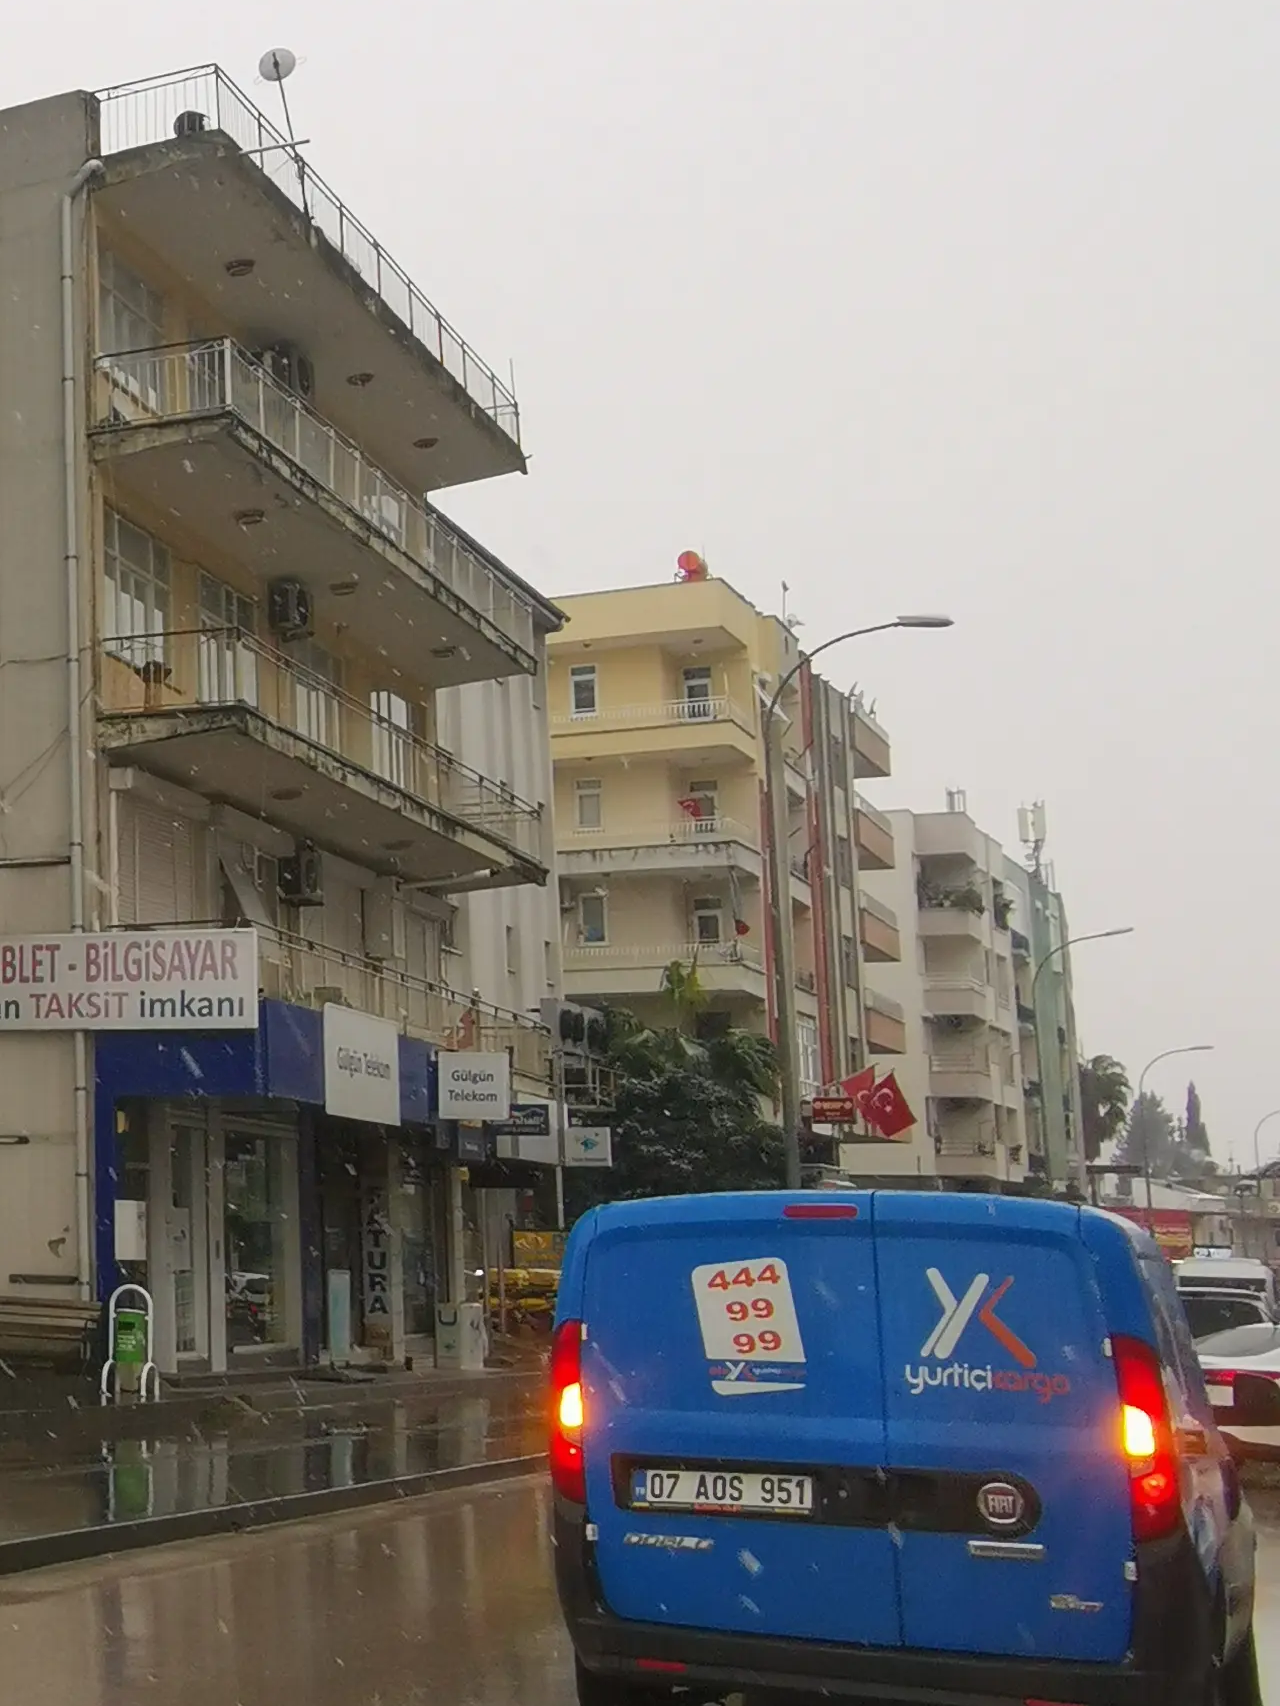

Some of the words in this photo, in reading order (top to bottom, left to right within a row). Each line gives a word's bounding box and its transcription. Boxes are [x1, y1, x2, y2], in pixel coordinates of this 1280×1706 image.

[139, 990, 244, 1019] imkanı
[451, 1070, 494, 1084] Gülgün
[448, 1089, 499, 1103] Telekom
[708, 1264, 781, 1291] 444
[726, 1298, 774, 1322] 99
[733, 1330, 782, 1354] 99
[650, 1473, 680, 1499] 07
[695, 1474, 744, 1502] AOS
[760, 1477, 806, 1505] 951
[987, 1495, 1014, 1514] FIAT
